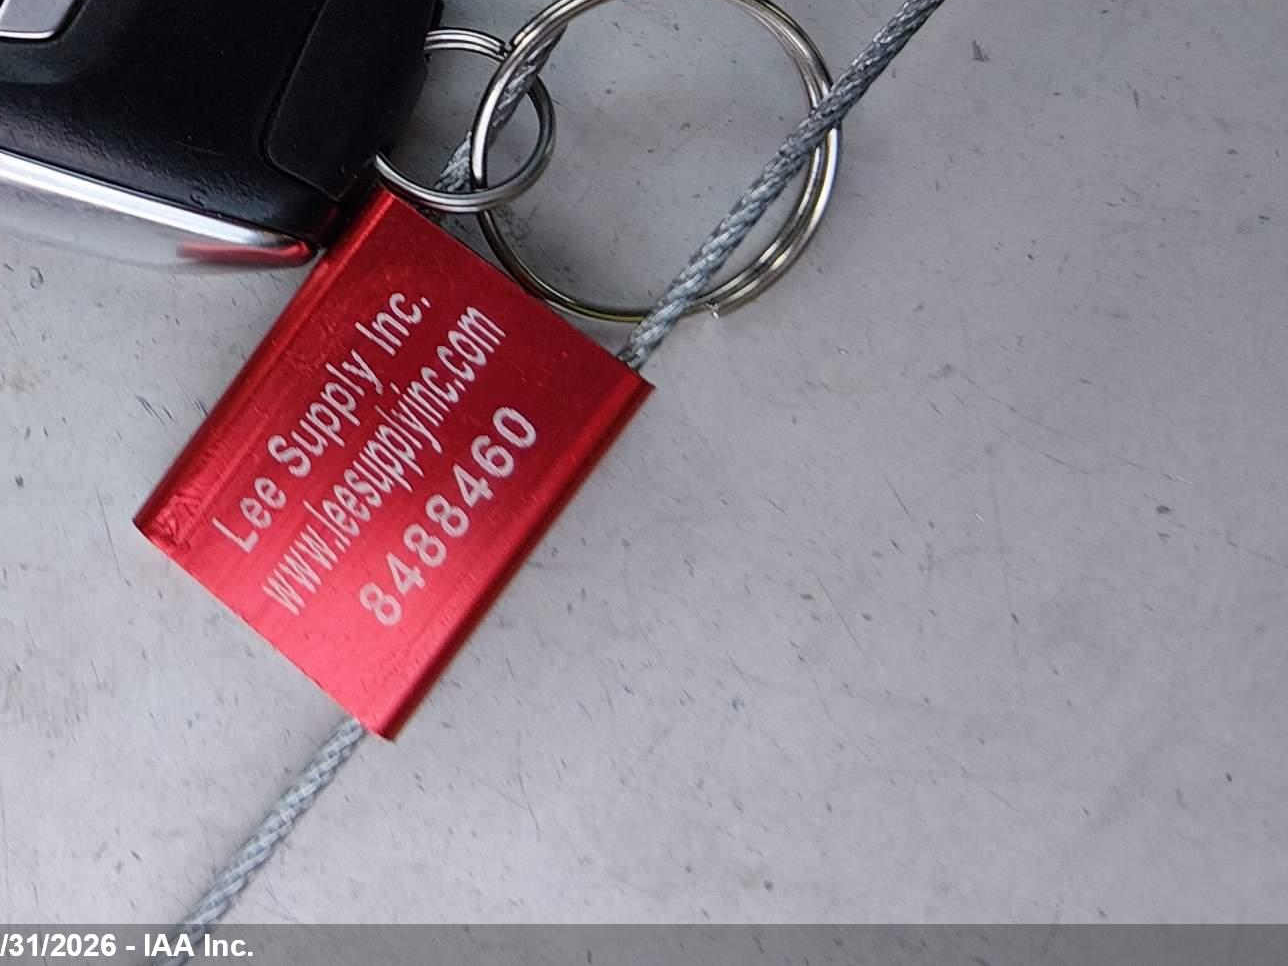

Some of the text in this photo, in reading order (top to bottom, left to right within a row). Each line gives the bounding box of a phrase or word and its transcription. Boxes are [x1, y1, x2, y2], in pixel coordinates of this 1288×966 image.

[212, 292, 431, 554] Lee Supply Inc.
[262, 305, 507, 616] www.leesupplyinc.com
[359, 406, 537, 627] 8488460
